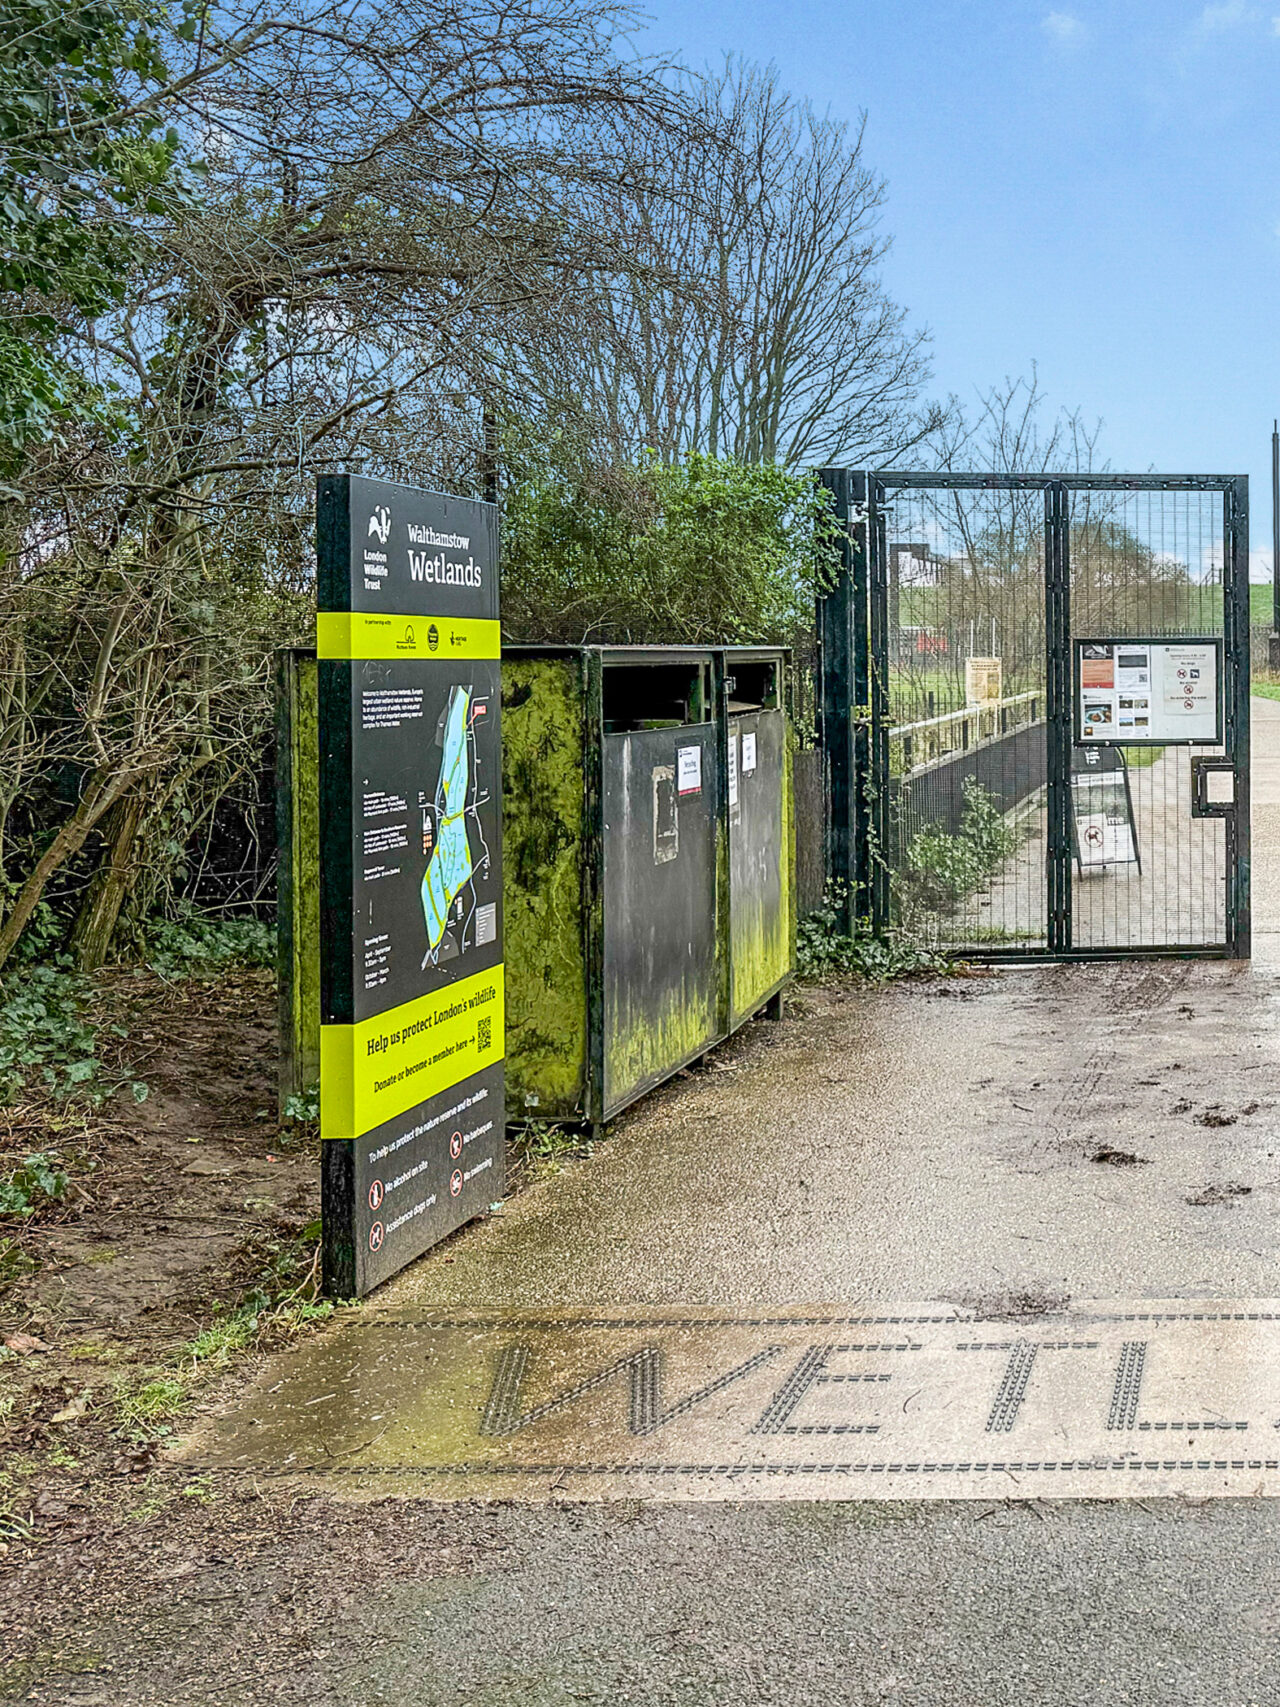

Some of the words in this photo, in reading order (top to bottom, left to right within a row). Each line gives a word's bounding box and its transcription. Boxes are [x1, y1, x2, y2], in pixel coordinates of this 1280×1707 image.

[408, 524, 469, 549] Walthamstow
[363, 549, 387, 562] London
[363, 564, 389, 577] Wildlife
[408, 550, 481, 587] Wetlands
[363, 578, 381, 590] Trust
[367, 1034, 389, 1056] Help
[390, 1032, 400, 1045] us
[402, 1017, 432, 1044] protect
[434, 999, 467, 1025] London's
[468, 986, 496, 1009] wildlife
[374, 1075, 397, 1093] Donate
[398, 1070, 404, 1080] or
[405, 1060, 427, 1077] become
[433, 1047, 455, 1064] member
[455, 1038, 467, 1053] here
[369, 1152, 377, 1164] To
[376, 1145, 389, 1158] help
[396, 1130, 415, 1150] protect
[385, 1182, 394, 1194] No
